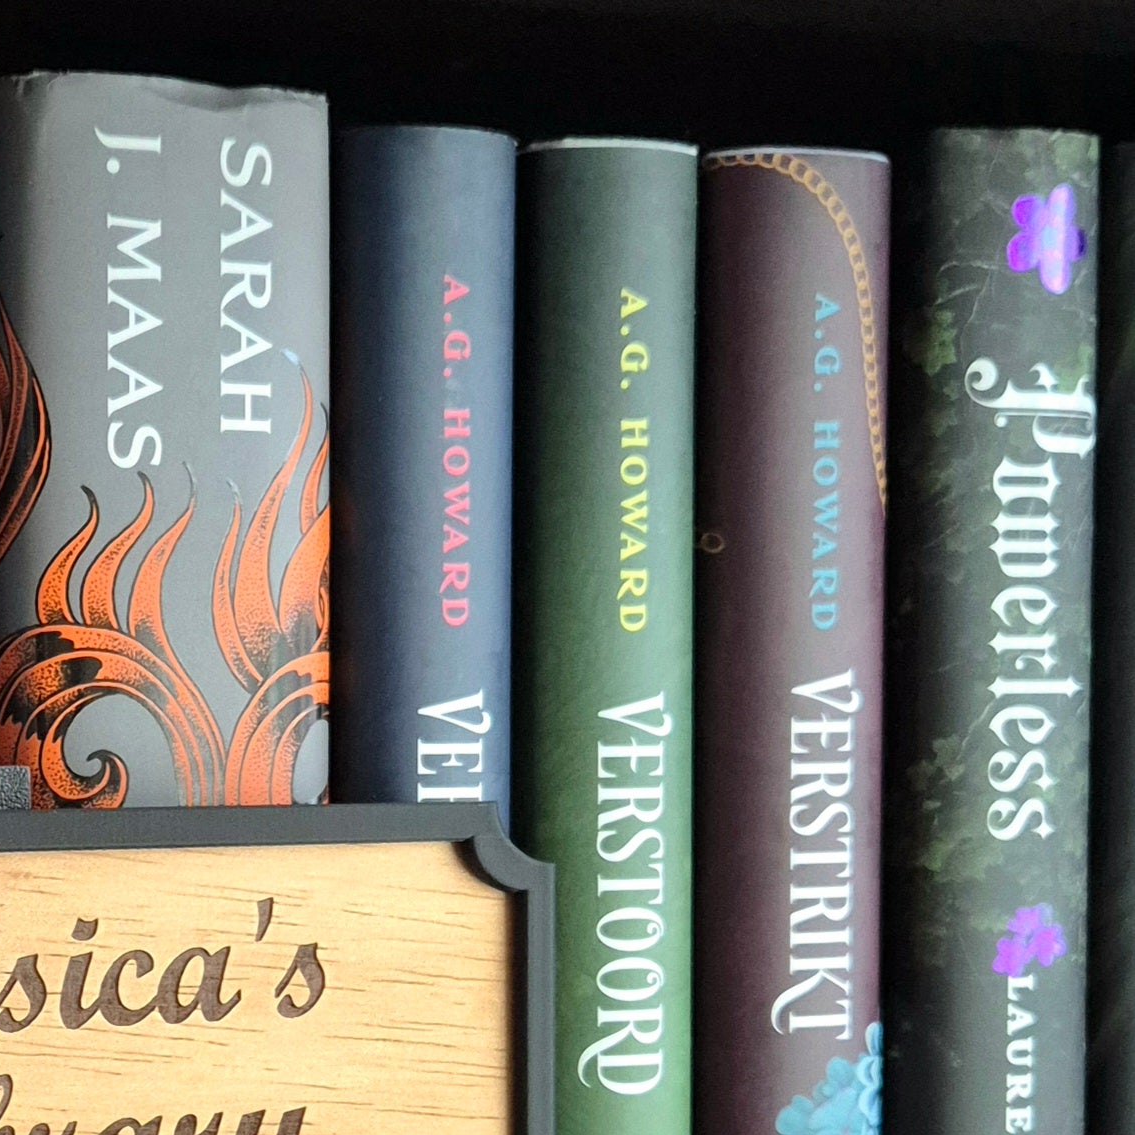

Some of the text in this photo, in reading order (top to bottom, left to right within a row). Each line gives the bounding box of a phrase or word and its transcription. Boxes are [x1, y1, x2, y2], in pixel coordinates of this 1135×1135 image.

[94, 125, 163, 469] J. MAAS
[220, 136, 273, 434] SARAH
[439, 274, 471, 627] A.G. HOWARD
[617, 287, 649, 633] A.G. HOWARD
[811, 293, 841, 631] A.G. HOWARD
[964, 357, 1096, 841] Powerless
[577, 691, 673, 1096] VERSTOORD
[771, 668, 863, 1040] VERSTRIKT
